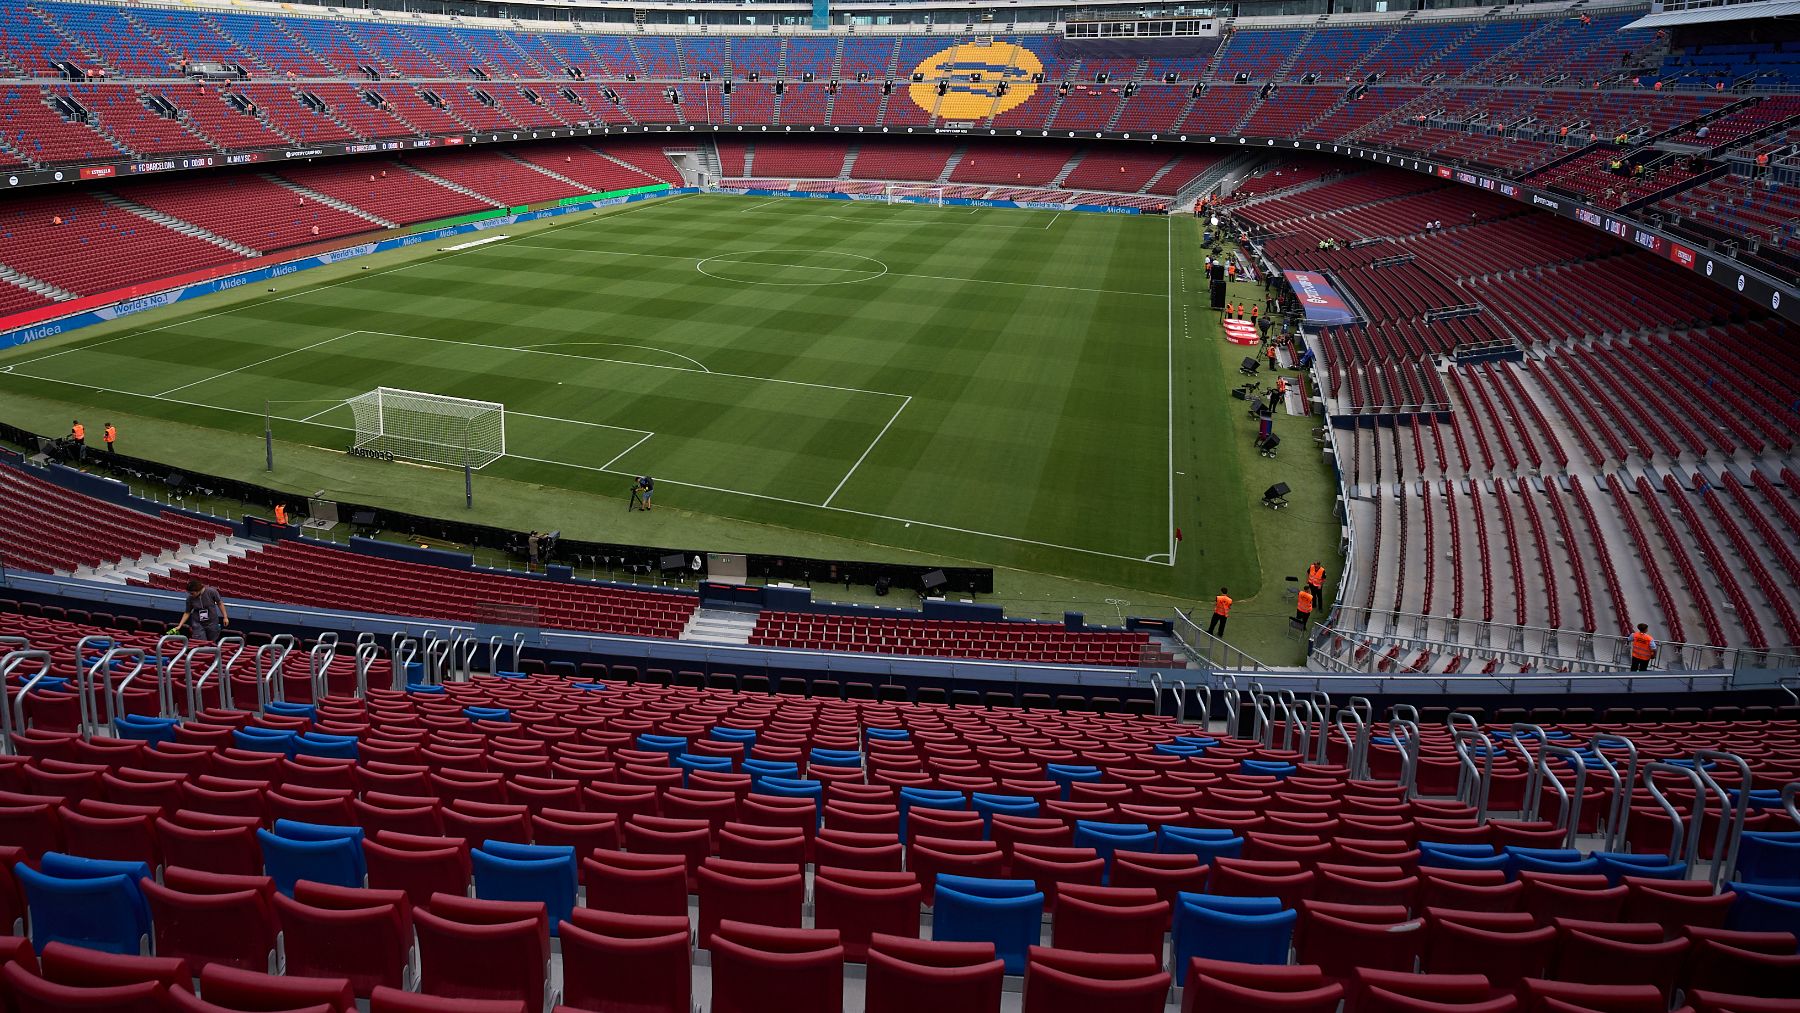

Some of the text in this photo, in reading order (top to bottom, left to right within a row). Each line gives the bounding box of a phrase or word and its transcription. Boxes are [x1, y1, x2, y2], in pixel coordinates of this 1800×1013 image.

[138, 161, 175, 172] FC BARCELONA
[183, 160, 188, 168] 0
[208, 158, 212, 166] 0
[440, 229, 458, 238] Midea
[402, 236, 422, 246] Midea
[330, 248, 354, 260] World's
[272, 266, 296, 278] Midea
[220, 277, 246, 290] Midea
[113, 300, 148, 314] World's
[150, 294, 168, 305] No.1
[22, 325, 62, 343] Midea
